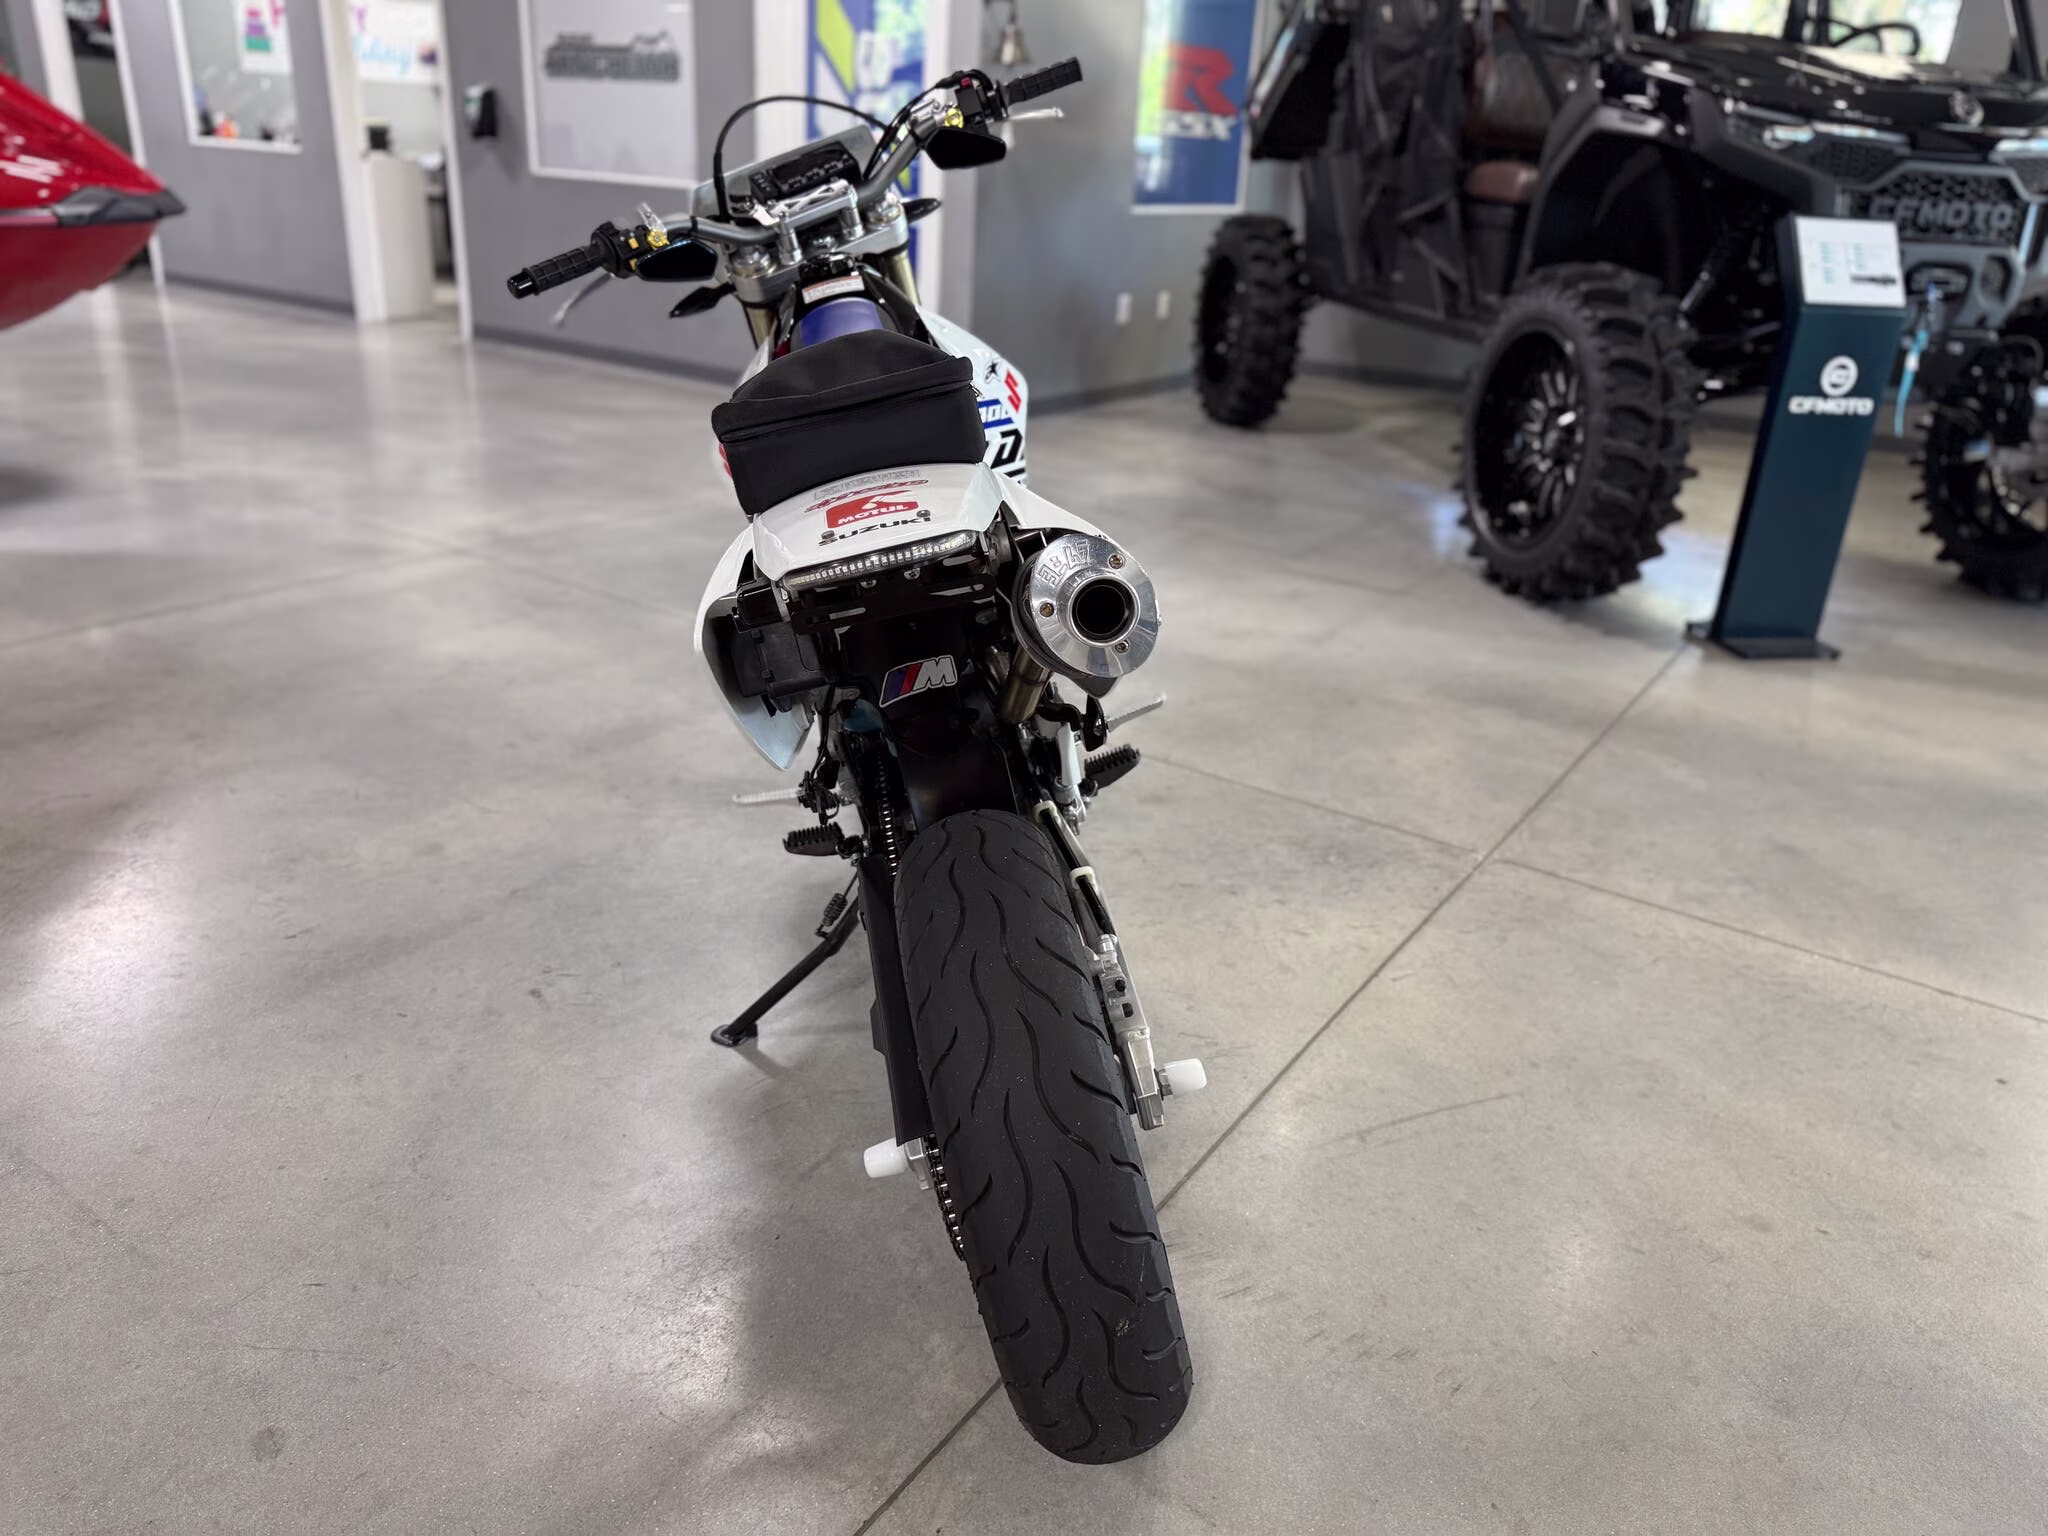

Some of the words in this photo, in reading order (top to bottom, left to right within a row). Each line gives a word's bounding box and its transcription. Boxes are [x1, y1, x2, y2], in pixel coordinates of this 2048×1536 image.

[1869, 195, 2014, 230] CFMOTO
[1788, 395, 1875, 415] CFMOTO
[838, 504, 909, 525] MOTUL
